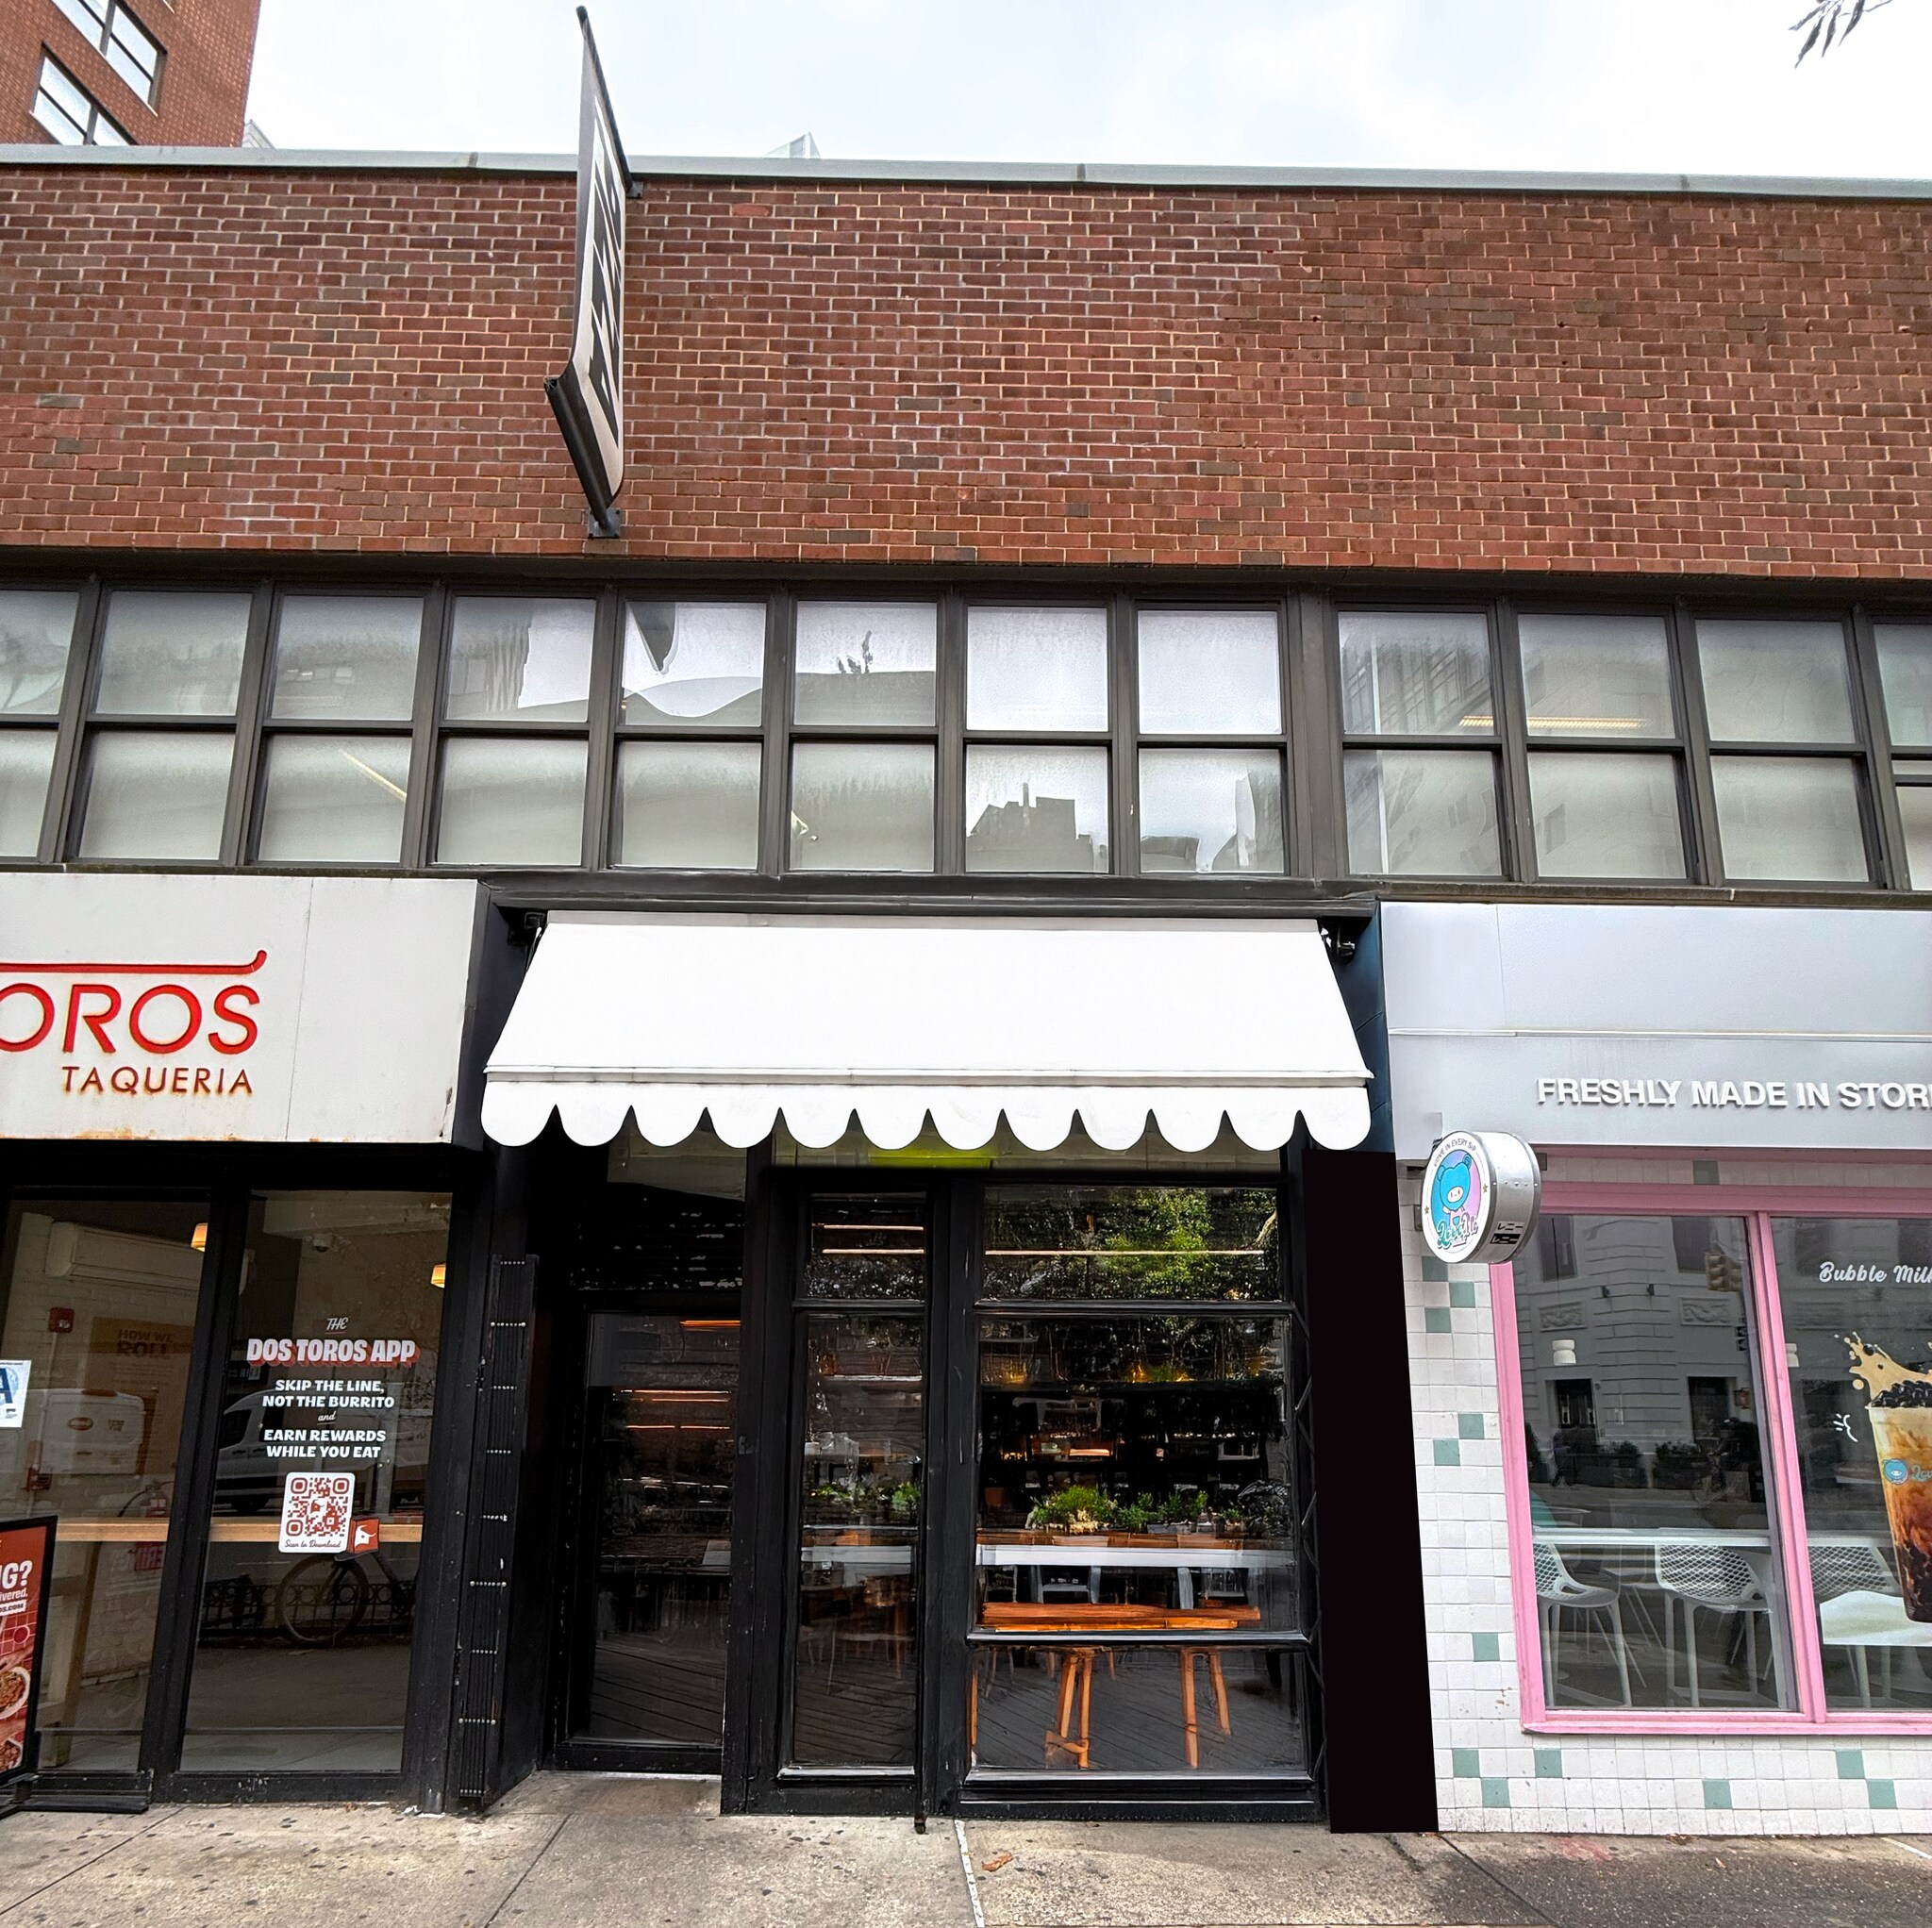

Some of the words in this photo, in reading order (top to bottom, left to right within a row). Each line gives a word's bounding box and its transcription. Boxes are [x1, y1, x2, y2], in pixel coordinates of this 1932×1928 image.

[589, 102, 622, 449] PIZZA
[62, 1066, 253, 1094] TAQUERIA
[1537, 1077, 1682, 1105] FRESHLY
[1691, 1081, 1789, 1108] MADE
[1795, 1082, 1831, 1108] IN
[1838, 1082, 1932, 1109] STOR
[1819, 1261, 1888, 1283] Bubble
[325, 1317, 350, 1332] THE
[246, 1338, 294, 1365] DOS
[296, 1339, 369, 1366] TOROS
[371, 1340, 418, 1365] APP
[275, 1379, 312, 1391] SKIP
[315, 1380, 343, 1391] THE
[346, 1380, 385, 1394] LINE,
[262, 1396, 294, 1408] NOT
[296, 1396, 325, 1408] THE
[328, 1397, 395, 1408] BURRITO
[317, 1411, 337, 1421] and
[263, 1429, 307, 1441] EARN
[309, 1430, 387, 1441] REWARDS
[266, 1445, 316, 1457] WHILE
[319, 1446, 350, 1457] YOU
[353, 1446, 381, 1458] EAT
[284, 1538, 299, 1548] Scan
[300, 1539, 308, 1548] to
[308, 1538, 342, 1548] Download
[0, 1559, 33, 1590] G?
